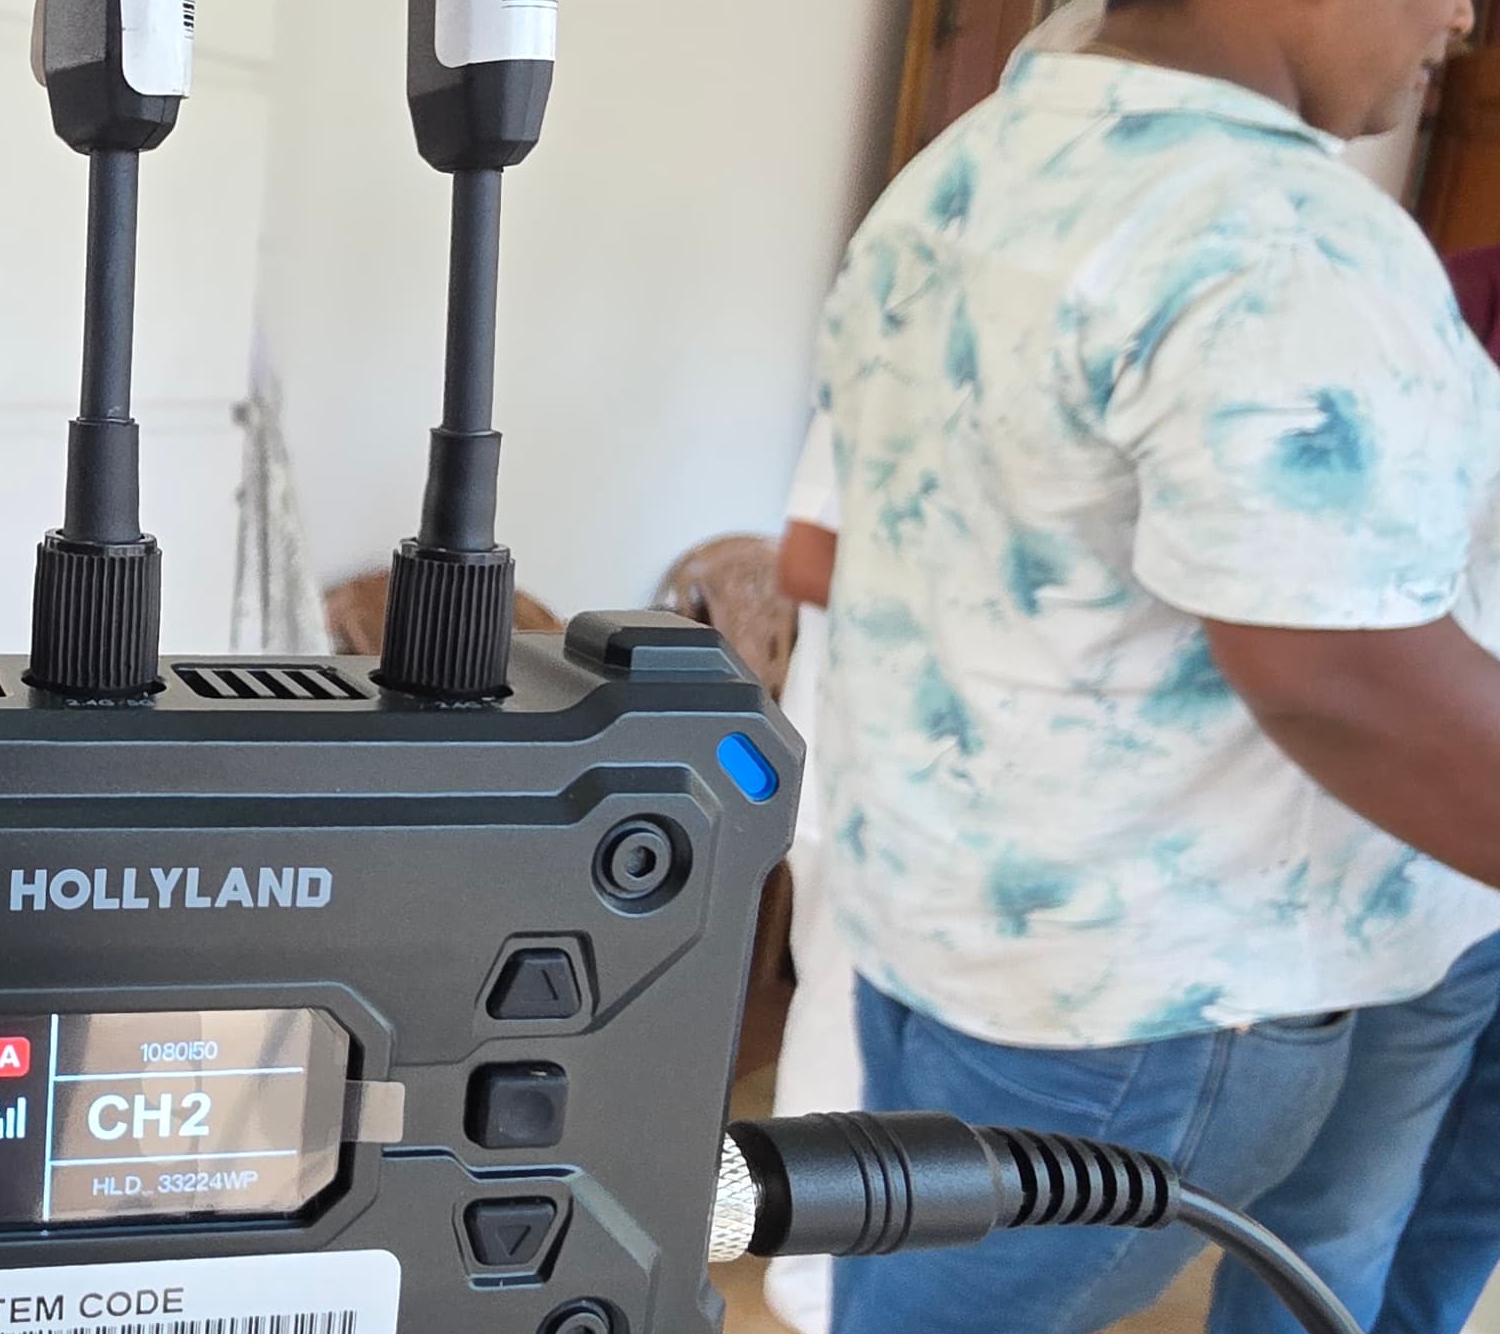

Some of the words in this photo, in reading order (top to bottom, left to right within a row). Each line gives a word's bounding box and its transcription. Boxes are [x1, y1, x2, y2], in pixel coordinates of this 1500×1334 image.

[9, 866, 333, 911] HOLLYLAND
[87, 1091, 212, 1141] CH2
[79, 1287, 185, 1319] CODE
